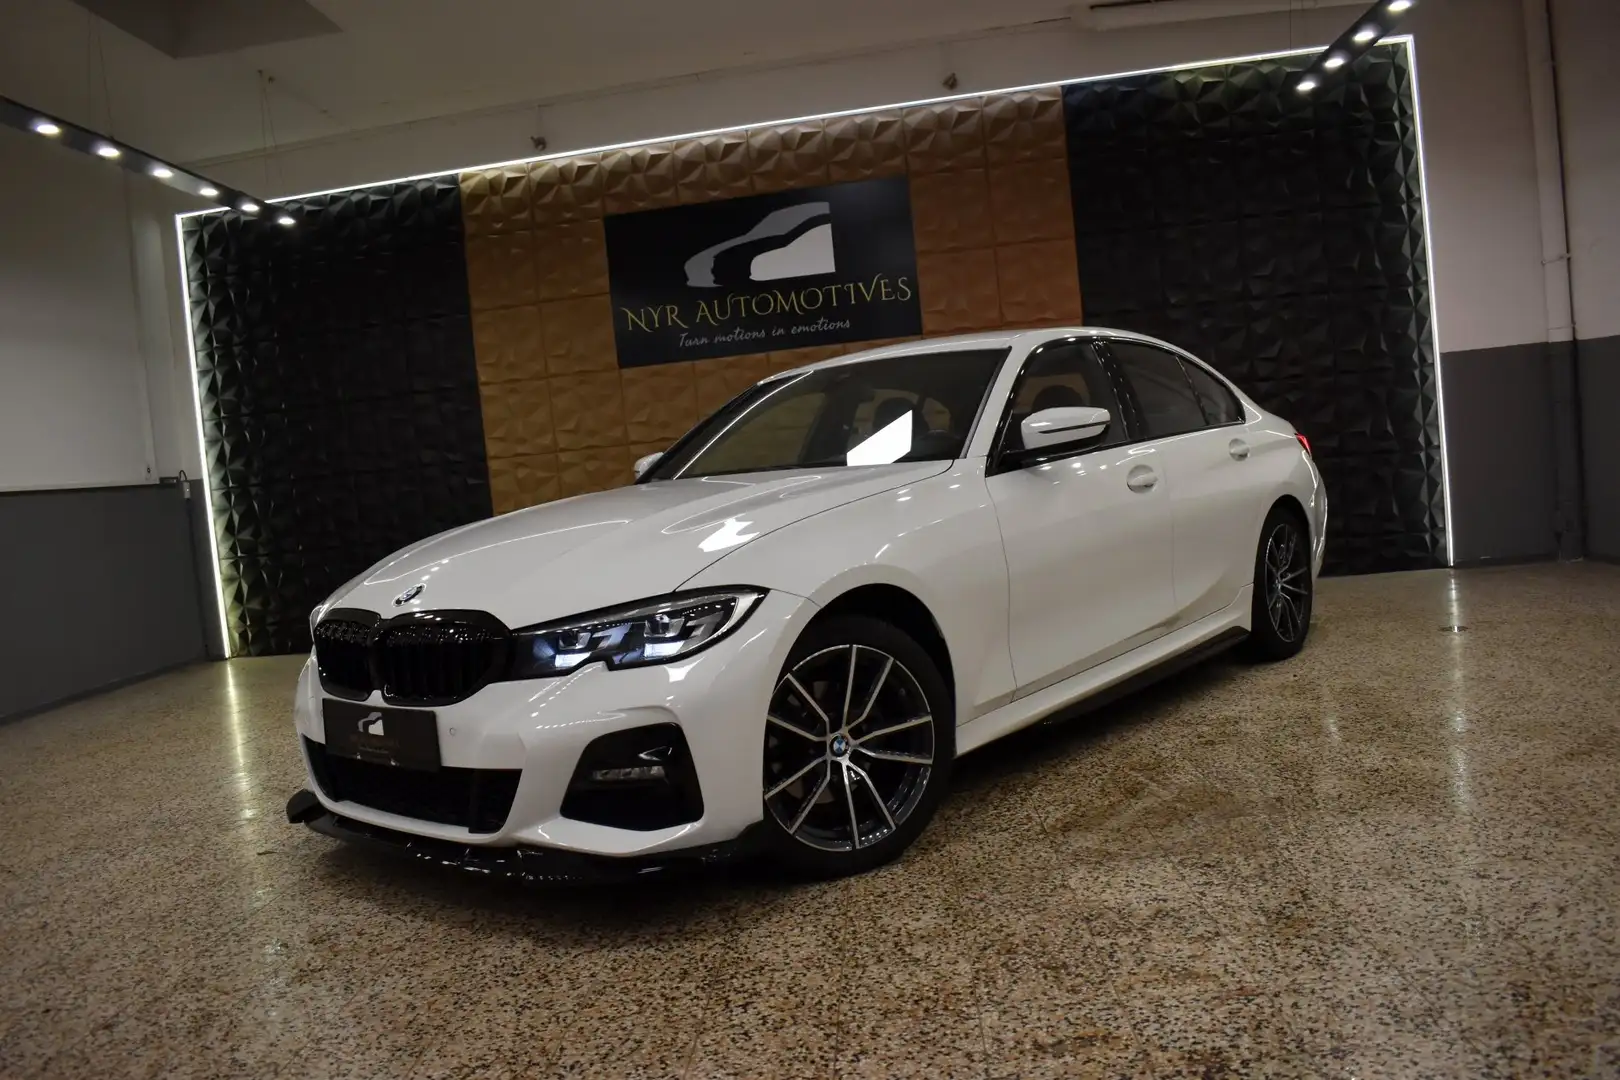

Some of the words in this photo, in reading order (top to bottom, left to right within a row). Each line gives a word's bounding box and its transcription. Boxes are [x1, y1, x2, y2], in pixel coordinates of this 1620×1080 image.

[621, 304, 688, 332] NYR
[695, 274, 911, 326] AUTOMOTIVES
[679, 331, 709, 348] Turn
[714, 327, 766, 345] motions
[772, 327, 785, 337] in
[791, 317, 851, 335] emotions
